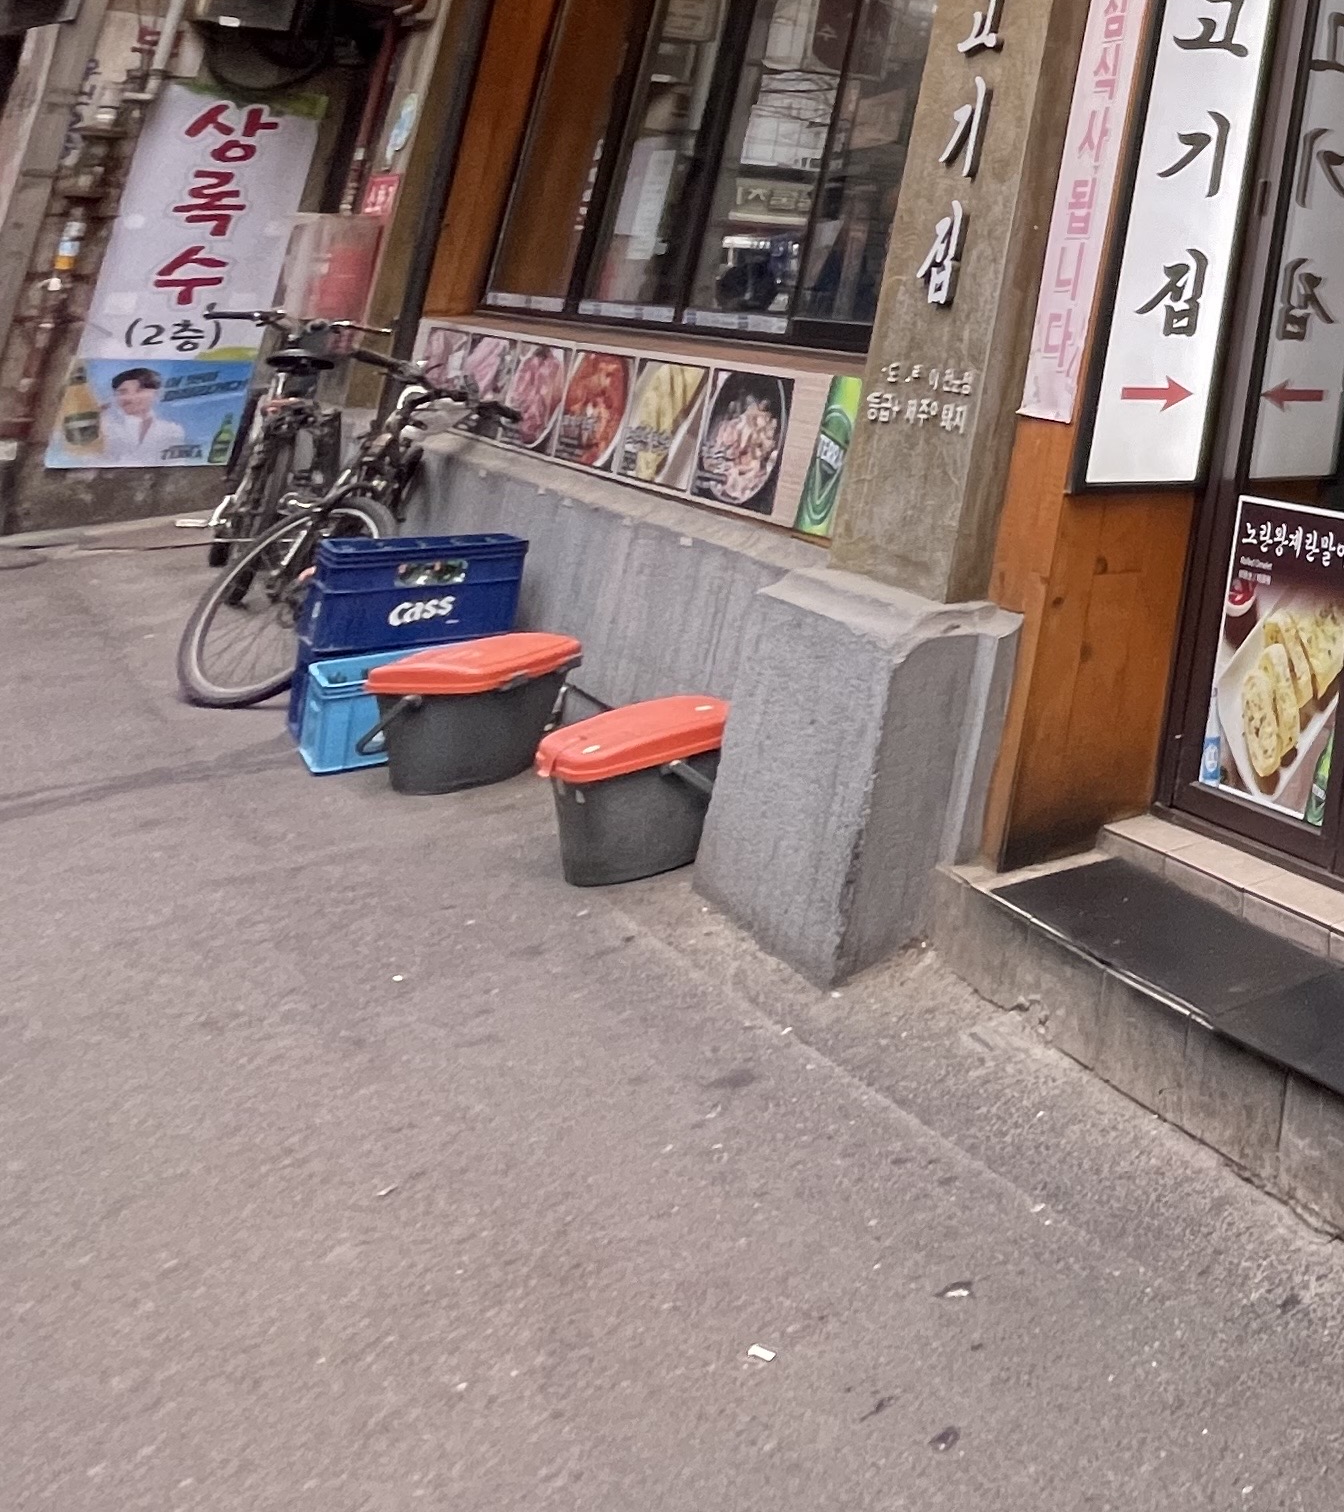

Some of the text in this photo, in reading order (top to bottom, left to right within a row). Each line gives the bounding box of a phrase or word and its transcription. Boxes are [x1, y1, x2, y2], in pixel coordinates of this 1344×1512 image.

[154, 104, 279, 305] 상록수
[125, 316, 222, 352] (2층)
[389, 595, 456, 627] Cass
